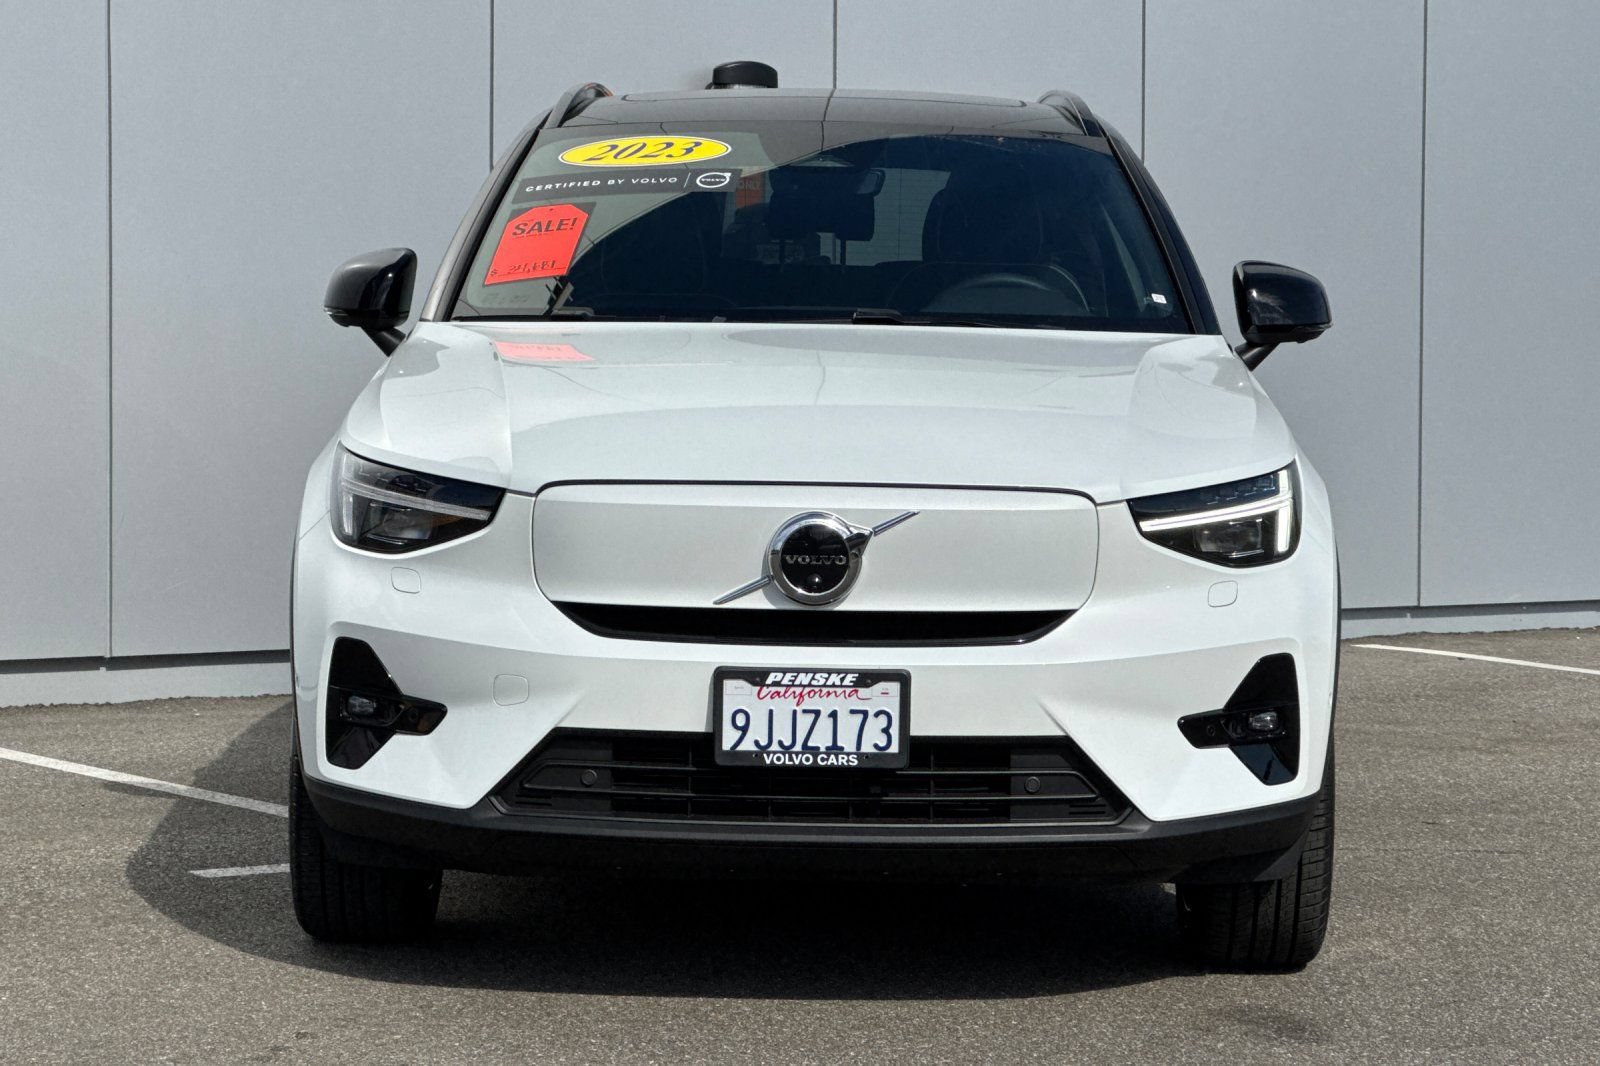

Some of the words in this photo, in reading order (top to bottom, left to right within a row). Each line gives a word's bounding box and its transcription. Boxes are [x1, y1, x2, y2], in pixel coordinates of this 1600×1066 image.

[583, 140, 702, 162] 2023
[525, 179, 601, 192] CERTIFIED
[631, 177, 678, 185] VOLVO
[512, 217, 578, 236] SALE!
[785, 554, 847, 565] VOLVO
[765, 672, 859, 686] PENSKE
[756, 686, 873, 707] California
[730, 708, 893, 751] 9JJZ173
[763, 753, 814, 765] VOLVO
[817, 753, 859, 766] CARS
